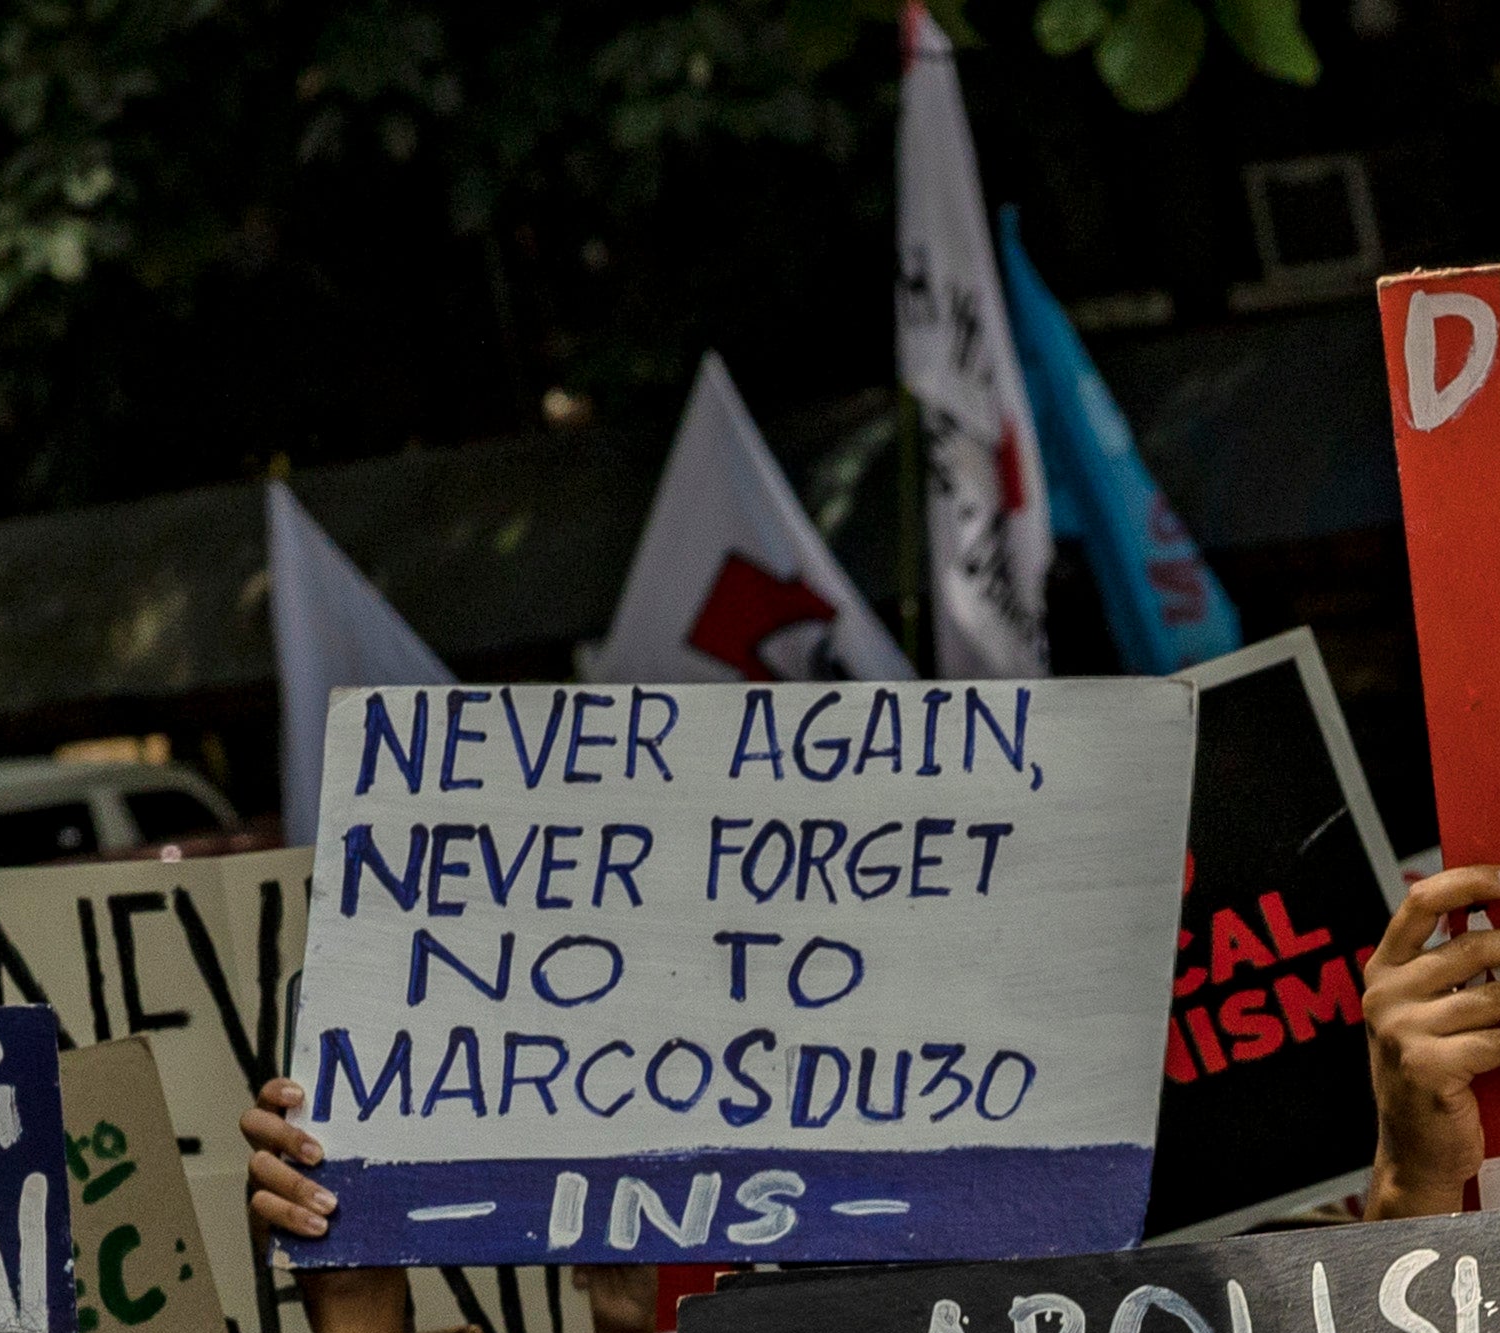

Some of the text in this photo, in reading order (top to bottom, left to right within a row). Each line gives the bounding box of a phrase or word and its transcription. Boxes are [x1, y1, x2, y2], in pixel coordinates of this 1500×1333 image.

[354, 686, 1046, 796] NEVER AGAIN,
[339, 816, 1016, 918] NEVER FORGET
[406, 928, 866, 1008] NO TO
